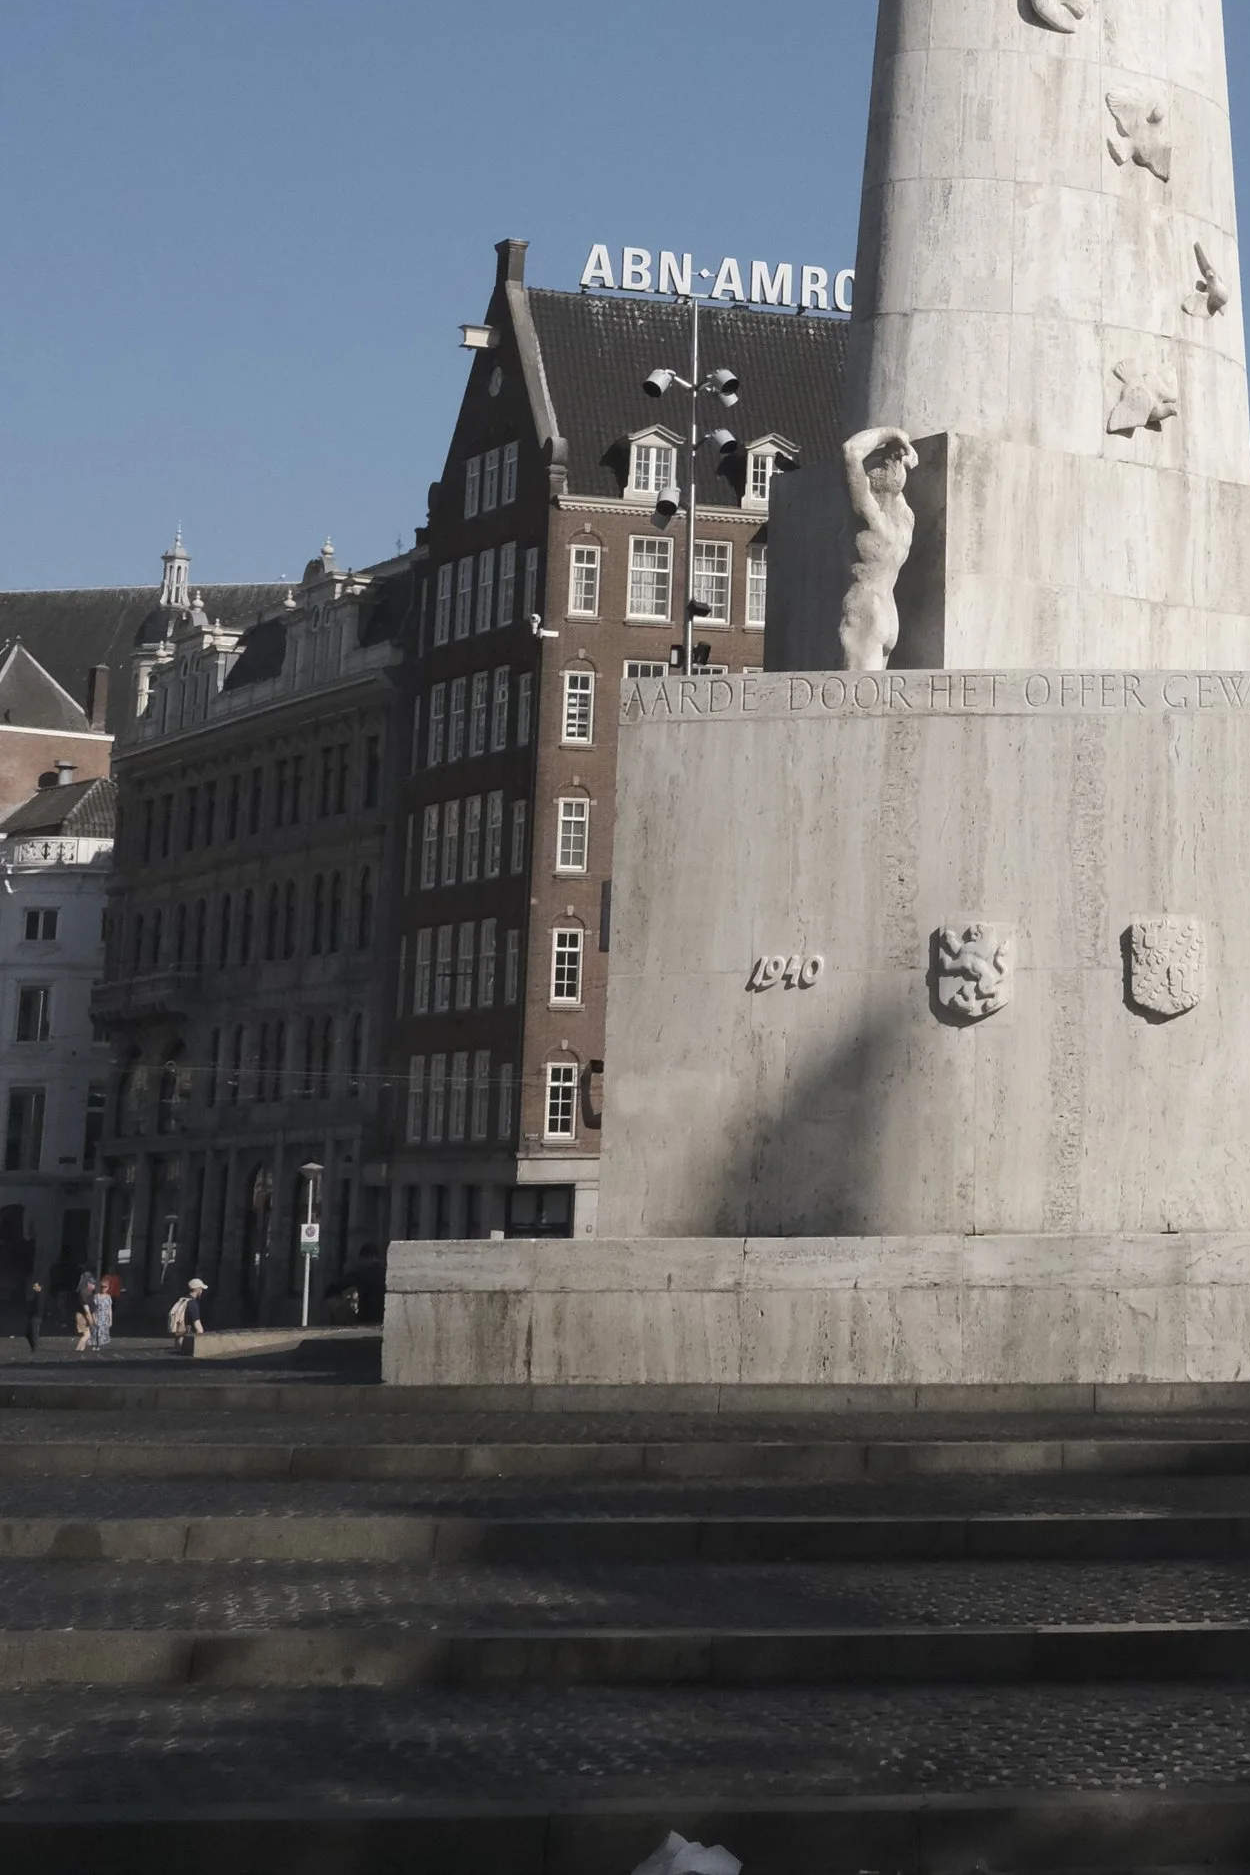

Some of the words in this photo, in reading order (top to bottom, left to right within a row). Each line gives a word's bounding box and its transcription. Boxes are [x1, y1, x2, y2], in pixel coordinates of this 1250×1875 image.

[579, 243, 692, 296] ABN
[624, 678, 758, 717] AARDE
[787, 675, 912, 711] DOOR
[928, 674, 1006, 710] HET
[1024, 673, 1147, 708] OFFER
[745, 954, 825, 993] 1940
